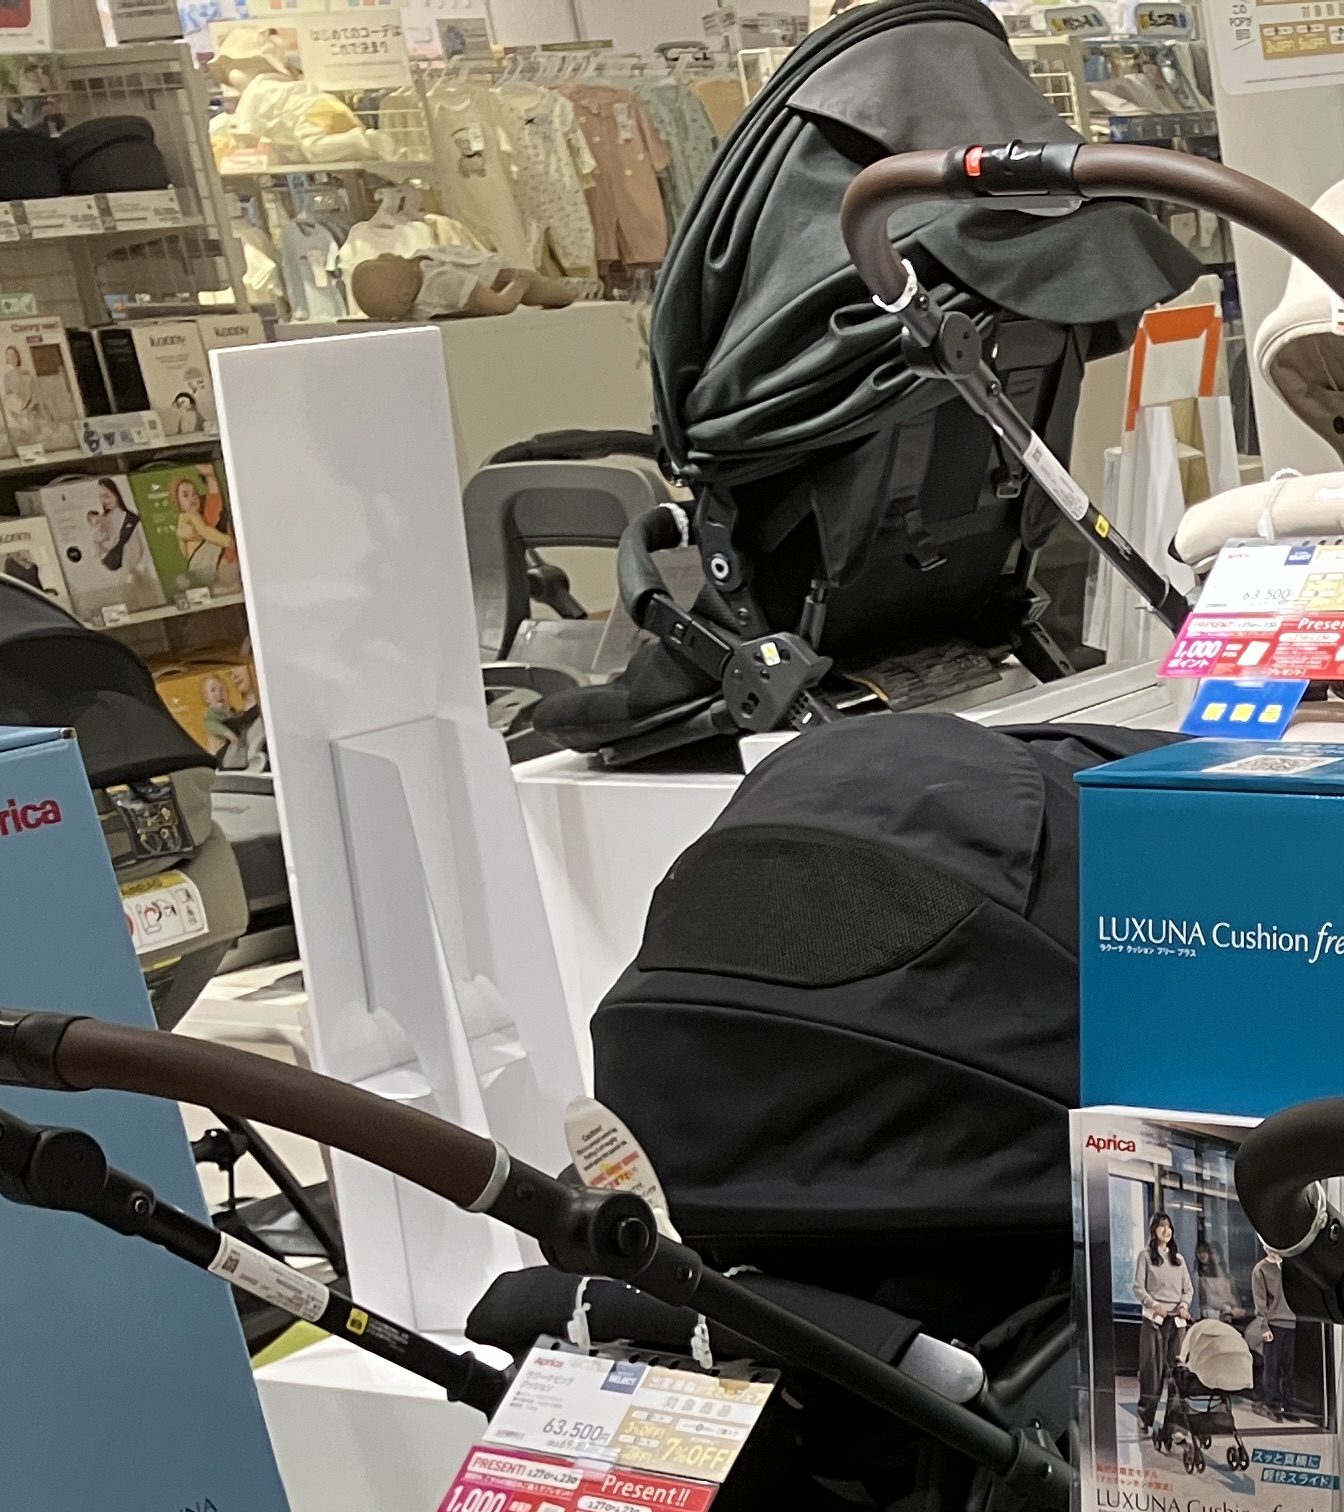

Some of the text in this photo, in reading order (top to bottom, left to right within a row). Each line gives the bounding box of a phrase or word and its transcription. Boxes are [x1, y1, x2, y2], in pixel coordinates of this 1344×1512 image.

[1174, 640, 1222, 658] 1,000
[1168, 659, 1210, 668] ポイント
[0, 798, 62, 836] rica
[1099, 916, 1206, 947] LUXUNA
[1212, 922, 1308, 952] Cushion
[1099, 944, 1197, 958] ラクーナ クッション フリー プラス
[1085, 1133, 1136, 1152] Aprica
[534, 1357, 564, 1368] Aprica
[608, 1374, 637, 1386] SELECT
[543, 1417, 611, 1443] 63,500円
[662, 1437, 737, 1471] 7%OFF!
[1253, 1449, 1319, 1468] スッと真横に
[472, 1456, 527, 1476] PRESENT!
[601, 1474, 691, 1508] Present!!
